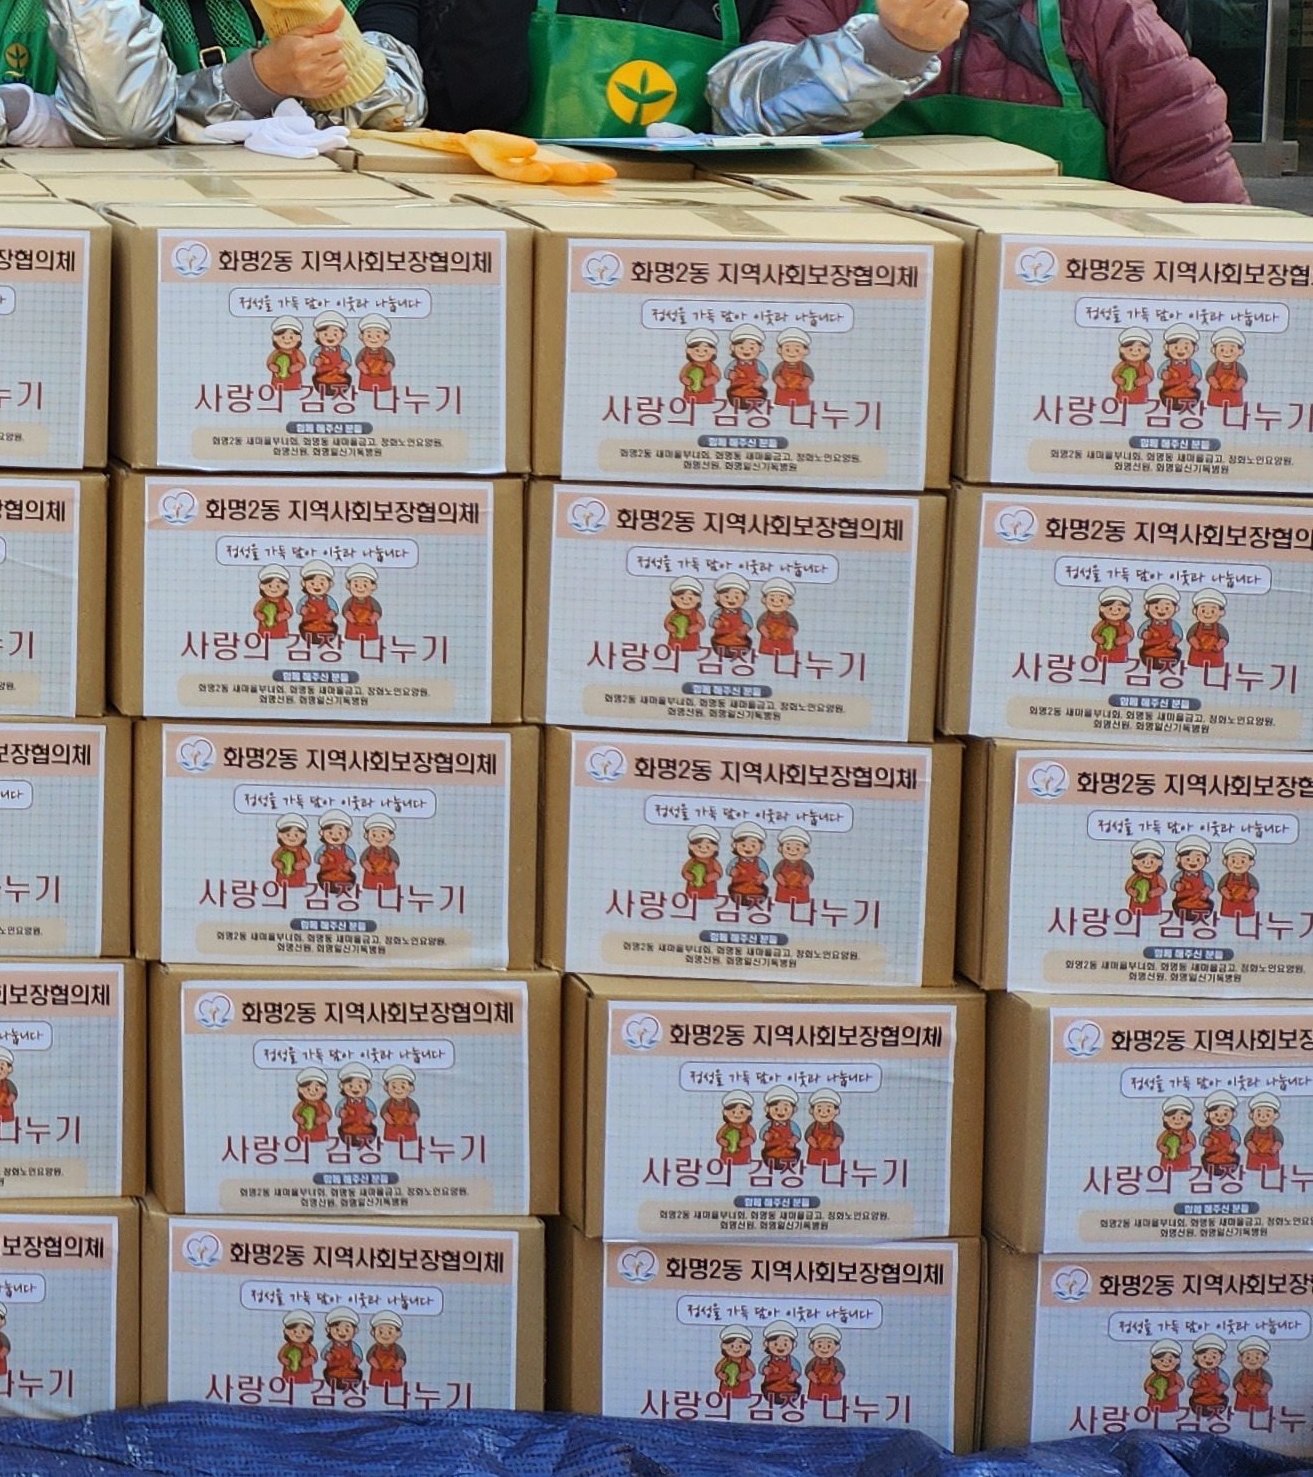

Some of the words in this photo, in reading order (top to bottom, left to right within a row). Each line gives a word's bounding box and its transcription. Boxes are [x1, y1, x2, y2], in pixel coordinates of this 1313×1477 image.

[631, 261, 710, 285] 화명2동
[717, 262, 918, 289] 지역사회보장협의체
[205, 498, 280, 522] 화명2동
[288, 500, 478, 525] 지역사회보장협의체
[181, 631, 270, 661] 사랑의
[286, 633, 344, 662] 김장
[360, 634, 448, 665] 나누기
[634, 756, 712, 782] 화명2동
[720, 760, 917, 791] 지역사회보장협의체
[606, 889, 698, 922] 사랑의
[714, 894, 774, 925] 김장
[789, 897, 881, 929] 나누기
[670, 1023, 745, 1047] 화명2동
[753, 1024, 942, 1049] 지역사회보장협의체
[643, 1158, 732, 1187] 사랑의
[748, 1159, 806, 1187] 김장
[821, 1159, 908, 1188] 나누기
[230, 1242, 305, 1267] 화명2동
[313, 1245, 503, 1275] 지역사회보장협의체
[666, 1257, 742, 1281] 화명2동
[750, 1259, 943, 1287] 지역사회보장협의체
